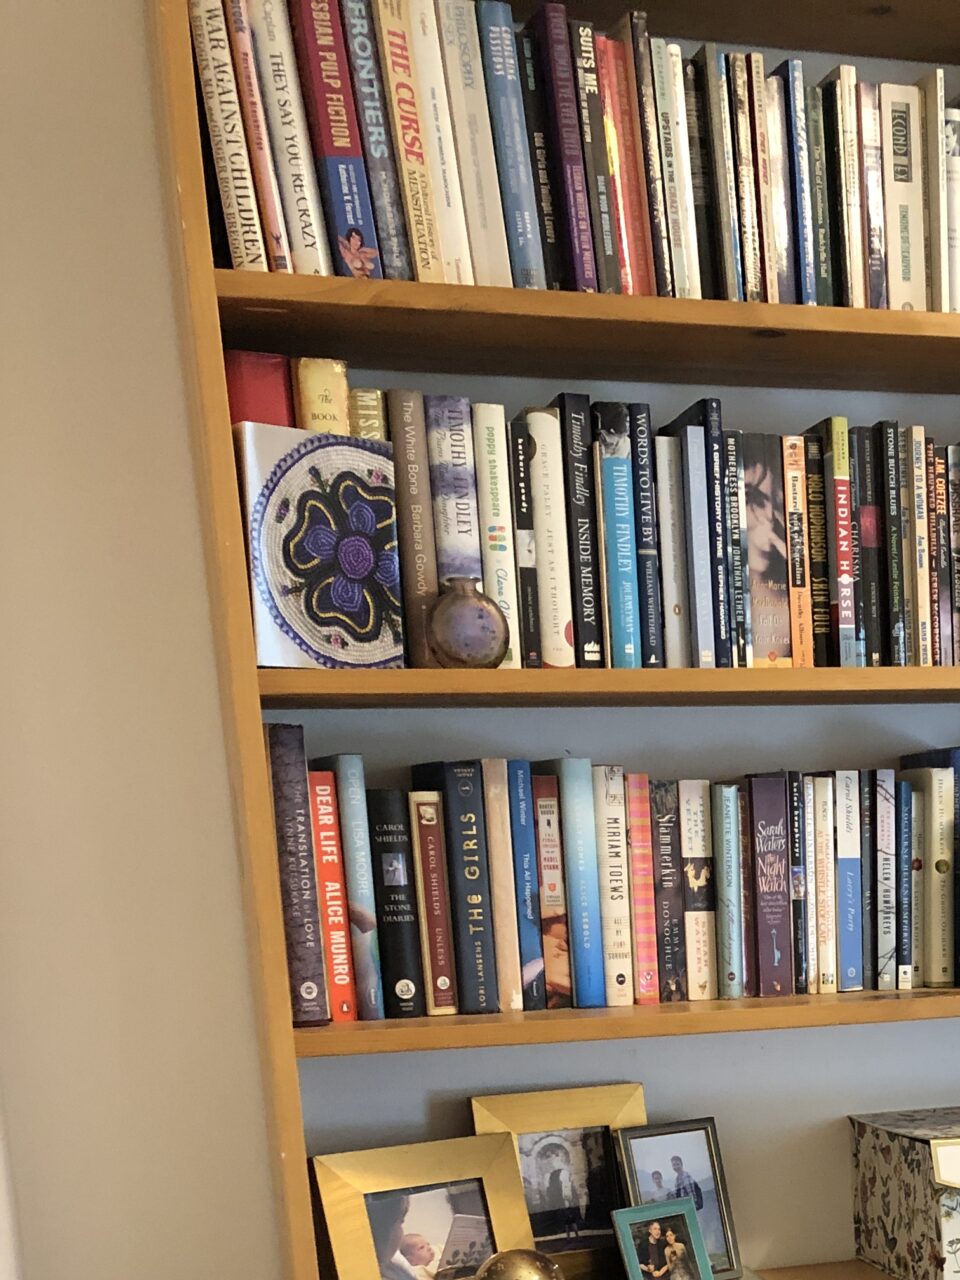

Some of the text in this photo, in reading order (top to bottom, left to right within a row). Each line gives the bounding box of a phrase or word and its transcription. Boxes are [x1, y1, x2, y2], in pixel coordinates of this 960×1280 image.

[269, 52, 290, 93] THEY
[387, 30, 424, 166] THE CURSE
[578, 27, 598, 95] SUITS ME
[204, 7, 263, 266] WAR AGAINST CHILDREN
[278, 99, 293, 129] SAY
[319, 52, 351, 149] PULP FICTION
[662, 112, 673, 159] UPSTAIRS
[667, 161, 673, 169] IN
[669, 186, 680, 217] CRAZY
[296, 197, 318, 252] CRAZY
[407, 169, 431, 270] MENSTRUATION
[673, 219, 682, 249] HOUSE
[447, 409, 472, 537] TIMOTHY FINDLEY
[484, 426, 502, 518] poppy shakespeare
[713, 444, 719, 452] A
[887, 428, 897, 516] STONE BUTCH BLUES
[402, 401, 427, 597] The White Bone Barbara Gowdy
[569, 413, 595, 626] Timothy Findley INSIDE MEMORY
[613, 465, 634, 575] TIMOTHY FINDLEY
[714, 480, 722, 521] HISTORY
[837, 486, 850, 553] INDIAN
[935, 457, 946, 516] J.M. COETZEE
[636, 413, 657, 647] WORDS TO LIVE BY WILLIAM WHITEHEAD
[716, 522, 722, 536] OF
[727, 438, 744, 623] MOTHERLESS BROOKLYN JONATHAN LETHEM
[516, 770, 525, 799] Michael
[519, 800, 527, 827] Winter
[347, 770, 369, 897] OPEN LISA MOORE
[522, 853, 530, 868] This
[606, 817, 623, 901] MIRIAM TOEWS
[656, 813, 677, 889] Slammerkin
[315, 785, 349, 985] DEAR LIFE ALICE MUNRO
[427, 836, 445, 966] CAROL SHIELDS UNLESS
[460, 813, 484, 935] THE GIRLS
[524, 883, 534, 920] Happened
